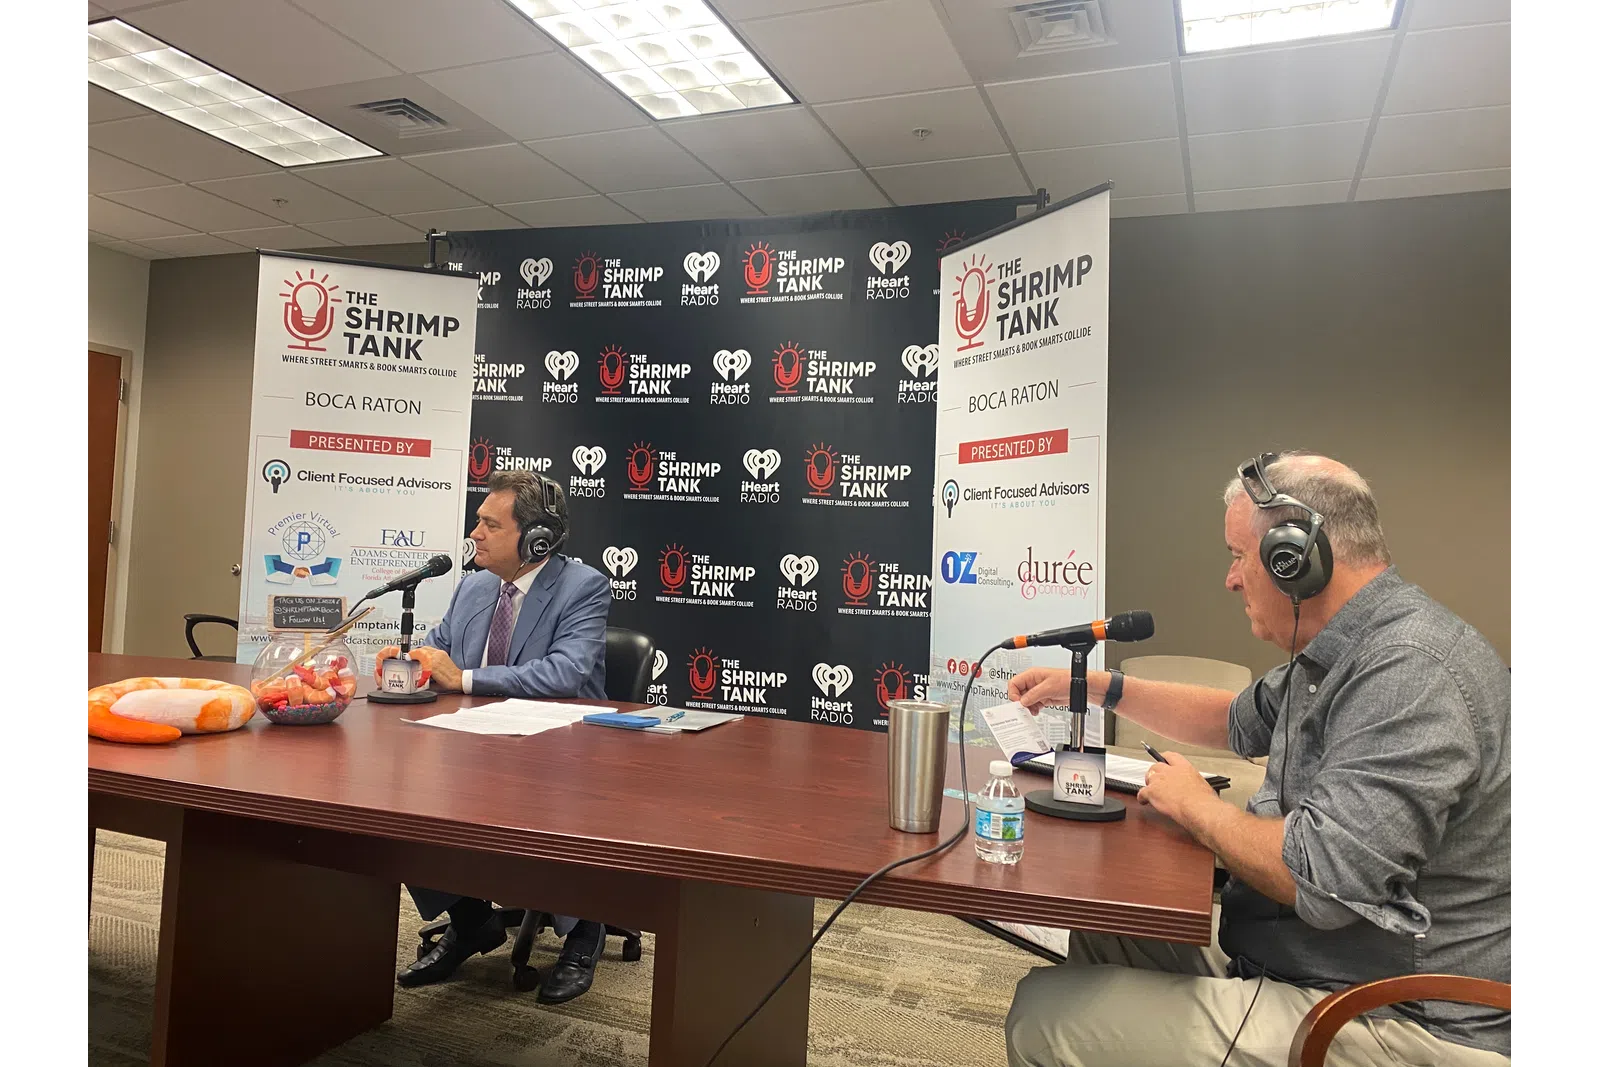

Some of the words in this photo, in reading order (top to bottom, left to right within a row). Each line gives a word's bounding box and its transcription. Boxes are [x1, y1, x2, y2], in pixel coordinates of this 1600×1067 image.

[778, 250, 797, 260] THE
[448, 262, 464, 272] THE
[604, 258, 621, 268] THE
[777, 256, 846, 277] SHRIMP
[998, 257, 1022, 280] THE
[604, 266, 664, 284] SHRIMP
[867, 276, 910, 288] iHeart
[997, 254, 1093, 310] SHRIMP
[603, 284, 645, 298] TANK
[681, 284, 720, 296] iHeart
[776, 274, 824, 294] TANK
[346, 290, 378, 306] THE
[517, 288, 552, 298] iHeart
[680, 294, 719, 306] RADIO
[794, 294, 806, 302] BOOK
[825, 292, 844, 300] COLLIDE
[866, 287, 910, 300] RADIO
[516, 298, 552, 308] RADIO
[344, 306, 460, 338] SHRIMP
[996, 298, 1060, 342] TANK
[343, 332, 423, 361] TANK
[954, 356, 972, 369] WHERE
[972, 352, 992, 364] STREET
[993, 345, 1016, 360] SMARTS
[1016, 344, 1020, 354] &
[1022, 340, 1038, 352] BOOK
[1038, 334, 1063, 348] SMARTS
[1064, 326, 1092, 342] COLLIDE
[630, 354, 648, 364] THE
[808, 350, 828, 360] THE
[282, 354, 309, 364] WHERE
[310, 356, 337, 367] STREET
[338, 359, 368, 370] SMARTS
[376, 364, 397, 372] BOOK
[398, 365, 427, 375] SMARTS
[428, 367, 458, 378] COLLIDE
[629, 363, 692, 379] SHRIMP
[807, 360, 877, 378] SHRIMP
[543, 382, 579, 392] iHeart
[628, 380, 672, 394] TANK
[711, 382, 751, 394] iHeart
[806, 377, 854, 394] TANK
[898, 380, 937, 392] iHear
[542, 392, 578, 403] RADIO
[710, 394, 750, 404] RADIO
[968, 390, 1007, 413] BOCA
[1011, 378, 1059, 406] RATON
[305, 391, 356, 410] BOCA
[362, 396, 422, 415] RATON
[308, 435, 392, 453] PRESENTED
[396, 442, 414, 454] BY
[496, 447, 512, 456] THE
[971, 440, 1034, 460] PRESENTED
[1038, 436, 1054, 453] BY
[658, 452, 678, 461] THE
[840, 454, 862, 464] THE
[495, 456, 552, 472] SHRIMP
[658, 461, 722, 478] SHRIMP
[840, 464, 912, 481] SHRIMP
[297, 470, 336, 484] Client
[338, 472, 394, 488] Focused
[396, 475, 452, 491] Advisors
[570, 476, 606, 488] iHeart
[658, 478, 702, 494] TANK
[742, 480, 780, 492] iHeart
[334, 485, 354, 493] IT'S
[359, 486, 392, 495] ABOUT
[396, 488, 416, 496] YOU
[570, 486, 606, 498] RADIO
[840, 482, 890, 498] TANK
[963, 488, 992, 502] Client
[994, 484, 1038, 500] Focused
[1039, 481, 1090, 497] Advisors
[740, 492, 780, 504] RADIO
[818, 498, 834, 506] STREET
[858, 500, 870, 508] BOOK
[871, 500, 890, 508] SMARTS
[890, 500, 910, 508] COLLIDE
[1010, 500, 1036, 508] ABOUT
[268, 512, 306, 536] Premier
[310, 510, 341, 538] Virtual
[380, 528, 426, 548] FAU
[350, 548, 388, 558] ADAMS
[390, 550, 428, 560] CENTER
[692, 554, 711, 564] THE
[691, 564, 756, 582] SHRIMP
[878, 563, 900, 573] THE
[978, 567, 998, 578] Digital
[1018, 546, 1093, 586] durée
[690, 580, 736, 598] TANK
[878, 574, 933, 591] SHRIM
[778, 586, 818, 601] iHeart
[877, 591, 928, 608] TANK
[777, 598, 818, 612] RADIO
[722, 658, 741, 668] THE
[721, 668, 788, 688] SHRIMP
[720, 686, 768, 704] TANK
[751, 706, 768, 714] SMARTS
[768, 707, 787, 715] COLLIDE
[812, 696, 854, 712] iHeart
[811, 708, 854, 725] RADIO
[1065, 788, 1092, 796] TANK
